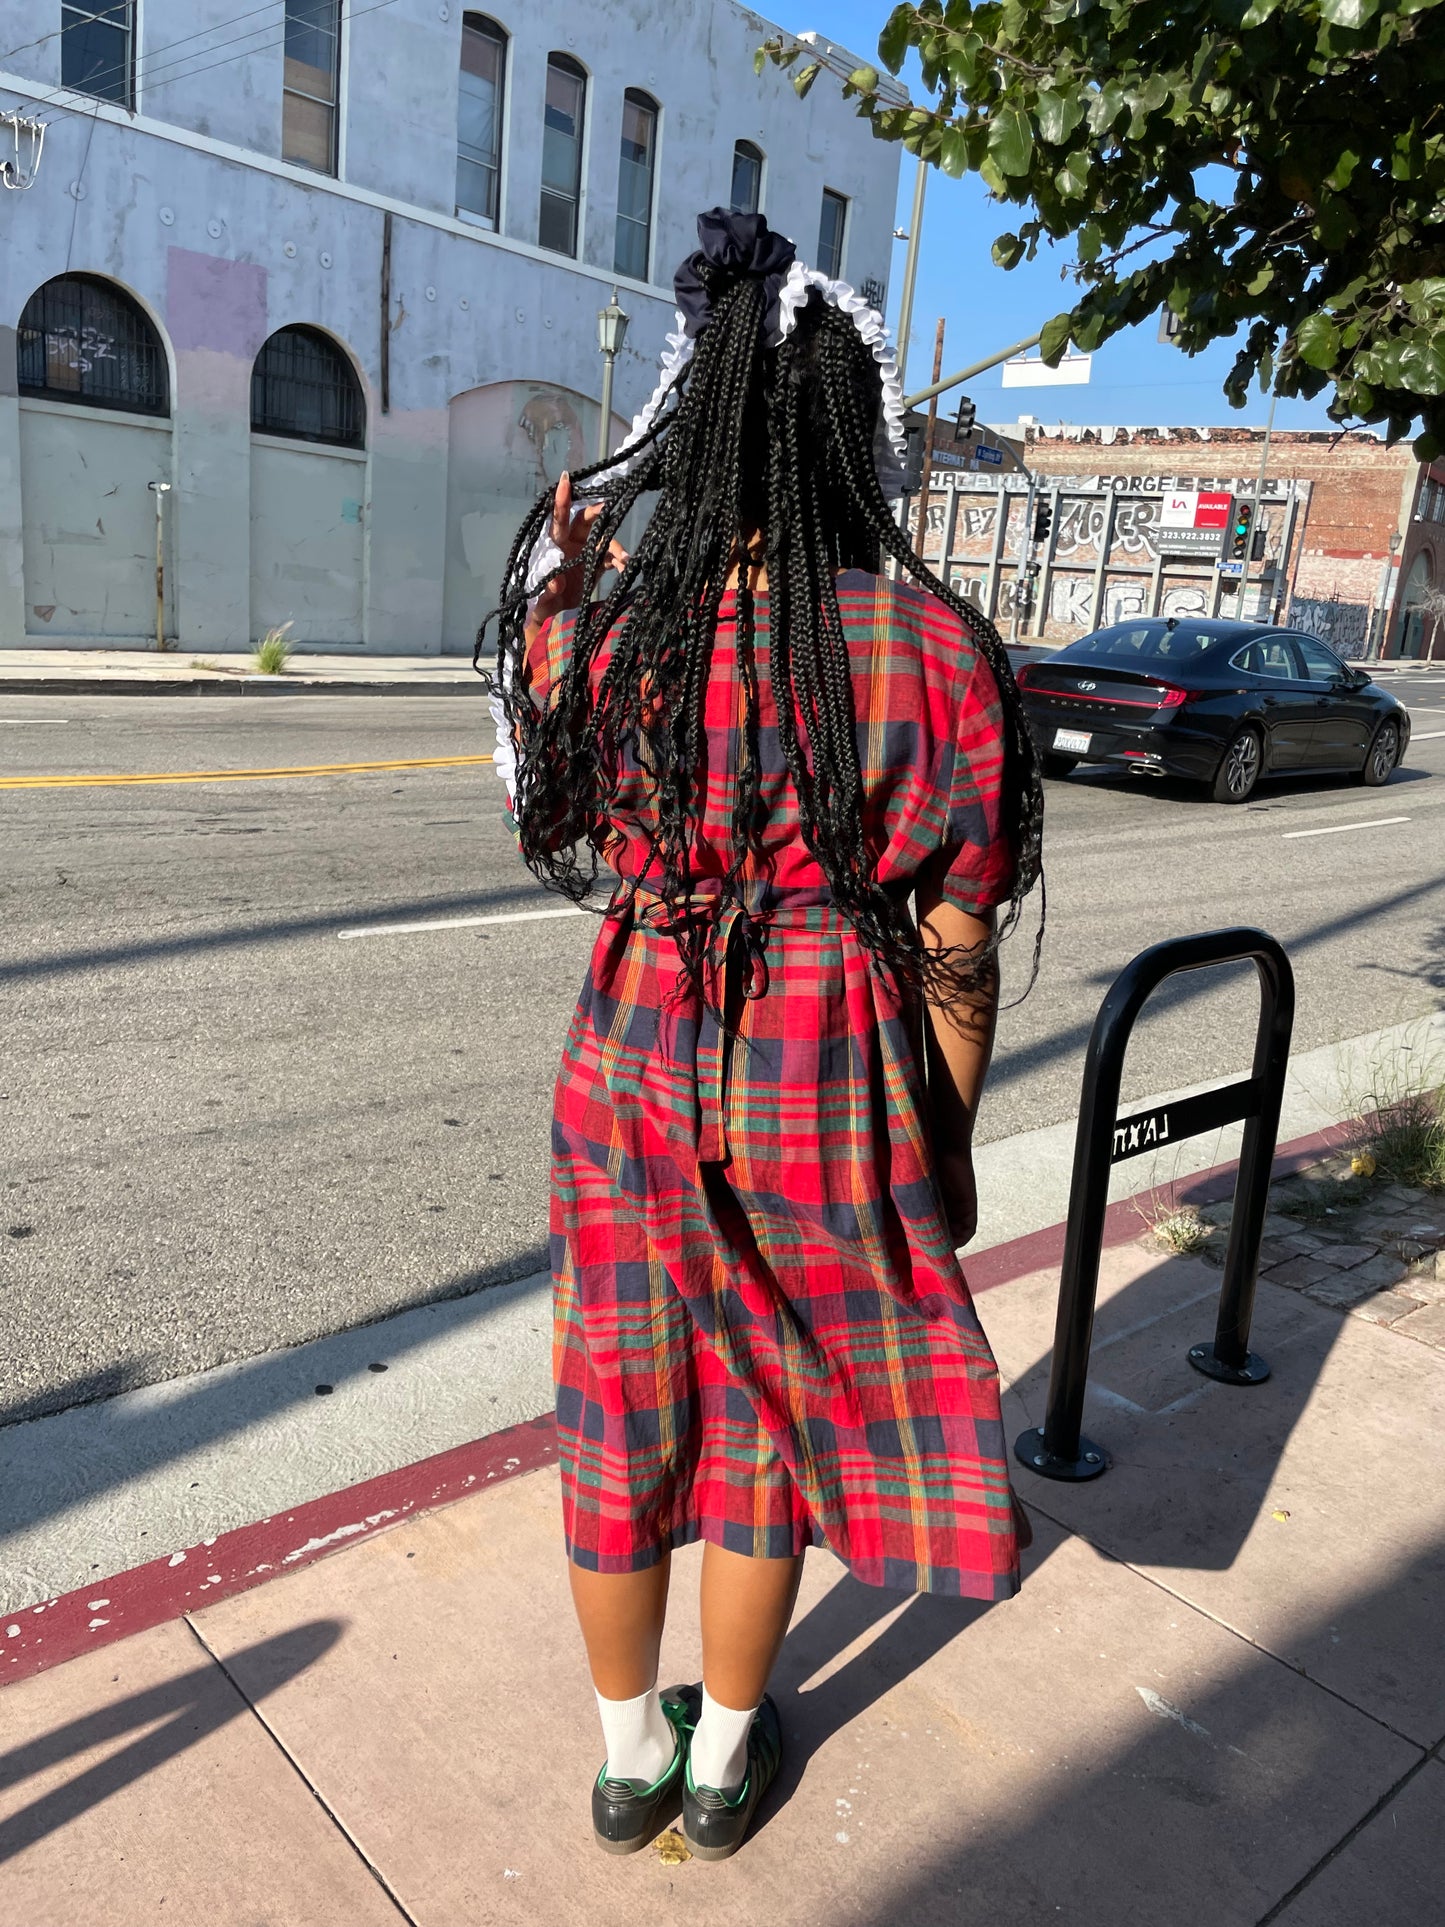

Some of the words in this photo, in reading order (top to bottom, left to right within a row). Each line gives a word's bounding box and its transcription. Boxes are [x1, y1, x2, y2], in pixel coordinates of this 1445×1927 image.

[1098, 475, 1172, 492] FORGE
[1197, 503, 1228, 511] AVAILABLE
[1162, 531, 1221, 541] 323.922.3832
